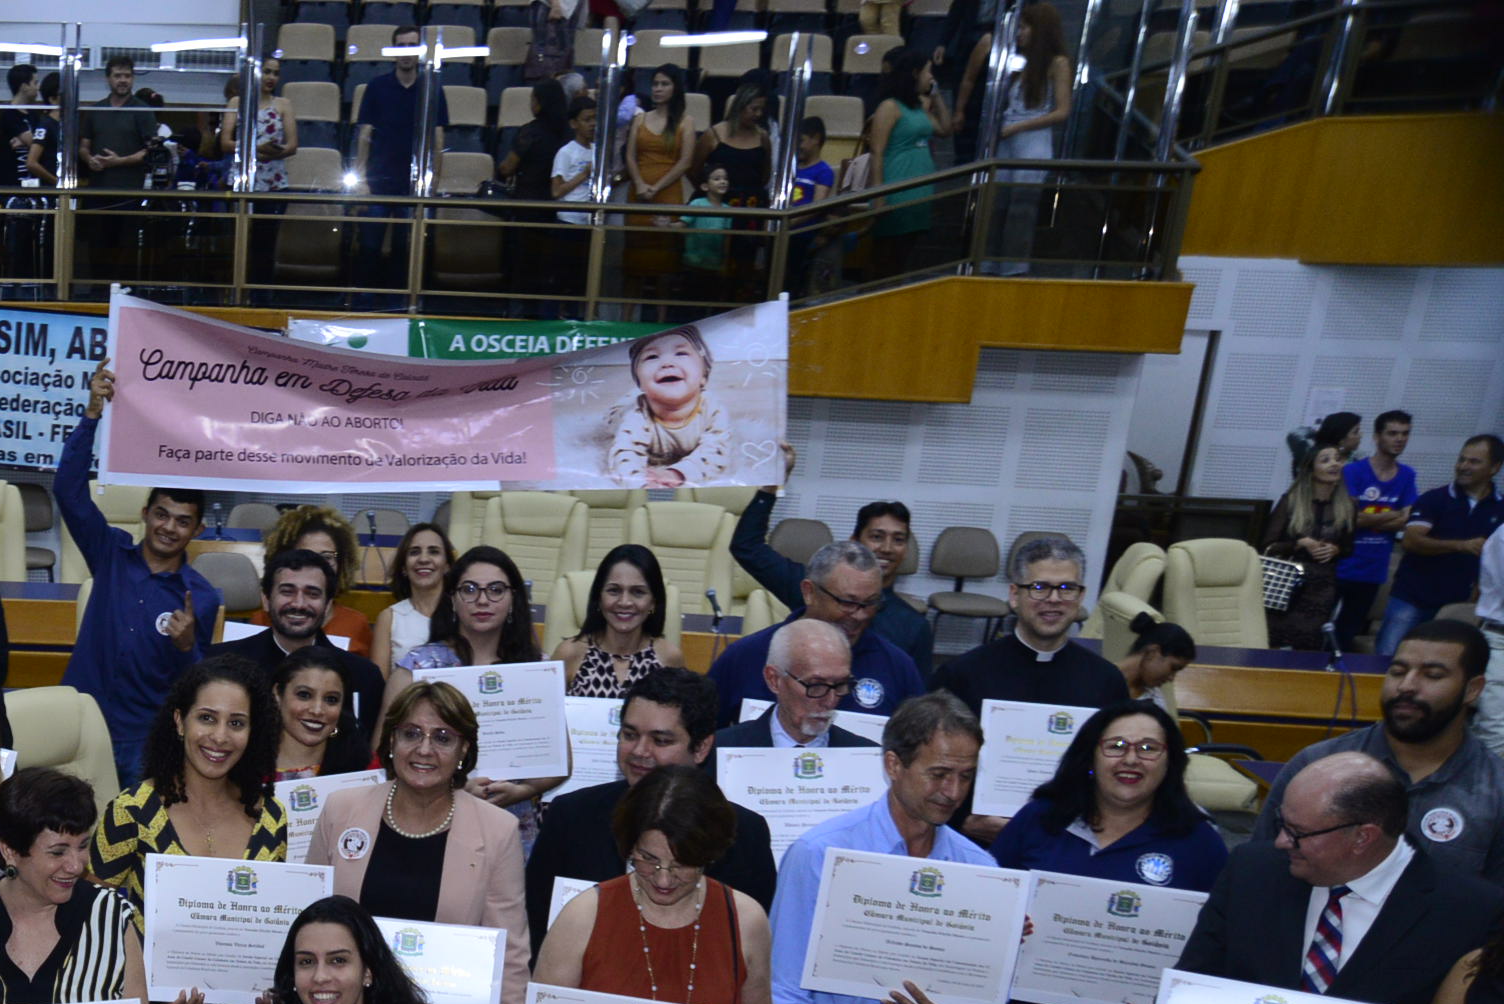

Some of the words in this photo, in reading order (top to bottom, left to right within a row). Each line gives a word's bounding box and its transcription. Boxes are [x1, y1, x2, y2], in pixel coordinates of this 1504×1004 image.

[449, 334, 466, 352] A
[470, 335, 551, 353] OSCEIA
[139, 348, 269, 390] Campanha
[274, 371, 313, 389] em
[318, 378, 412, 404] Defesa
[250, 411, 284, 424] DIGA
[288, 412, 318, 426] NÃO
[321, 415, 342, 427] AO
[345, 416, 404, 430] ABORTO!
[24, 451, 54, 465] em
[158, 444, 190, 462] Faça
[195, 449, 234, 463] parte
[237, 449, 277, 463] desse
[281, 452, 362, 466] movimento
[365, 453, 383, 467] de
[385, 452, 467, 468] Valorização
[471, 453, 488, 465] da
[492, 451, 527, 465] Vida!
[178, 898, 214, 910] Diploma
[217, 901, 227, 910] de
[231, 901, 257, 912] Honra
[261, 905, 271, 913] ao
[273, 904, 303, 915] Mérito
